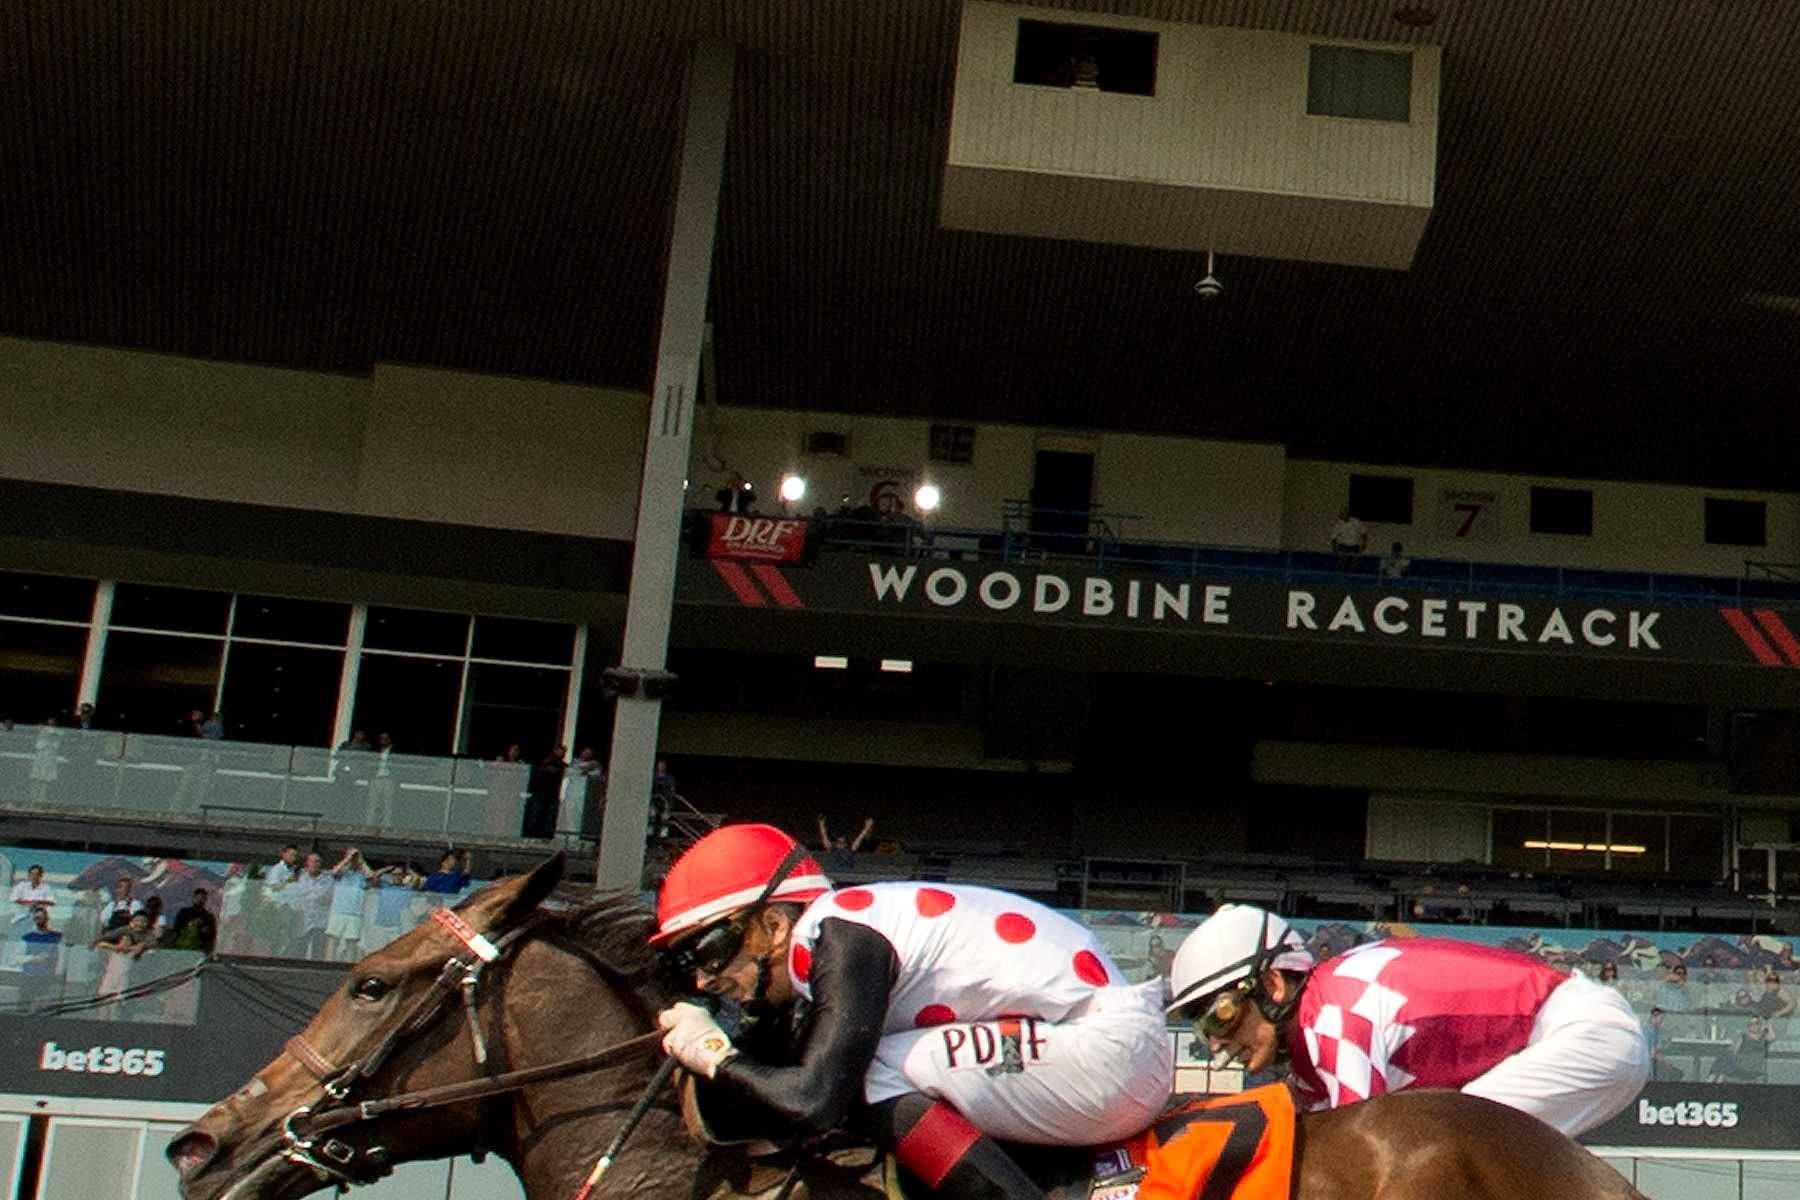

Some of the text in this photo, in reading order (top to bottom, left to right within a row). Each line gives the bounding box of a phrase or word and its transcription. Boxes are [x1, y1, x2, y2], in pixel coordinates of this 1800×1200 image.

[720, 517, 800, 546] DRF
[1454, 503, 1482, 538] 7
[869, 562, 1662, 650] WOODBINE RACETRACK
[42, 1040, 166, 1076] bet365
[1639, 1099, 1738, 1128] bet365
